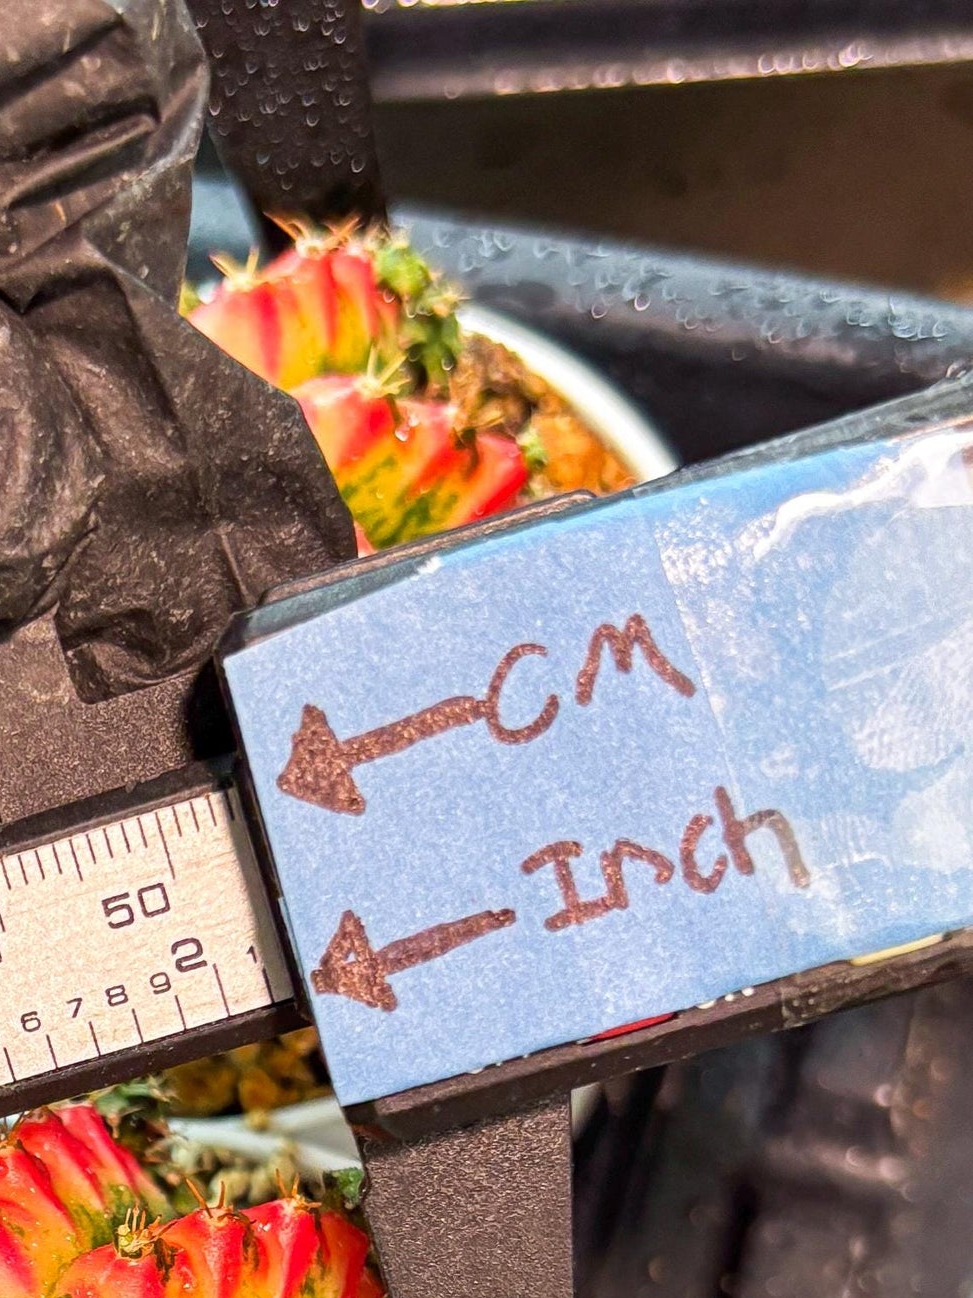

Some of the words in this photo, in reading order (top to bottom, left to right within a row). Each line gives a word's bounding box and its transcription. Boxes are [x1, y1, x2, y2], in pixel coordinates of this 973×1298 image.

[100, 882, 171, 930] 50
[521, 785, 811, 932] Inch
[20, 1011, 42, 1033] 6
[66, 998, 83, 1018] 7
[104, 985, 129, 1008] 8
[149, 972, 172, 995] 9
[170, 938, 208, 973] 2
[246, 945, 258, 964] 1
